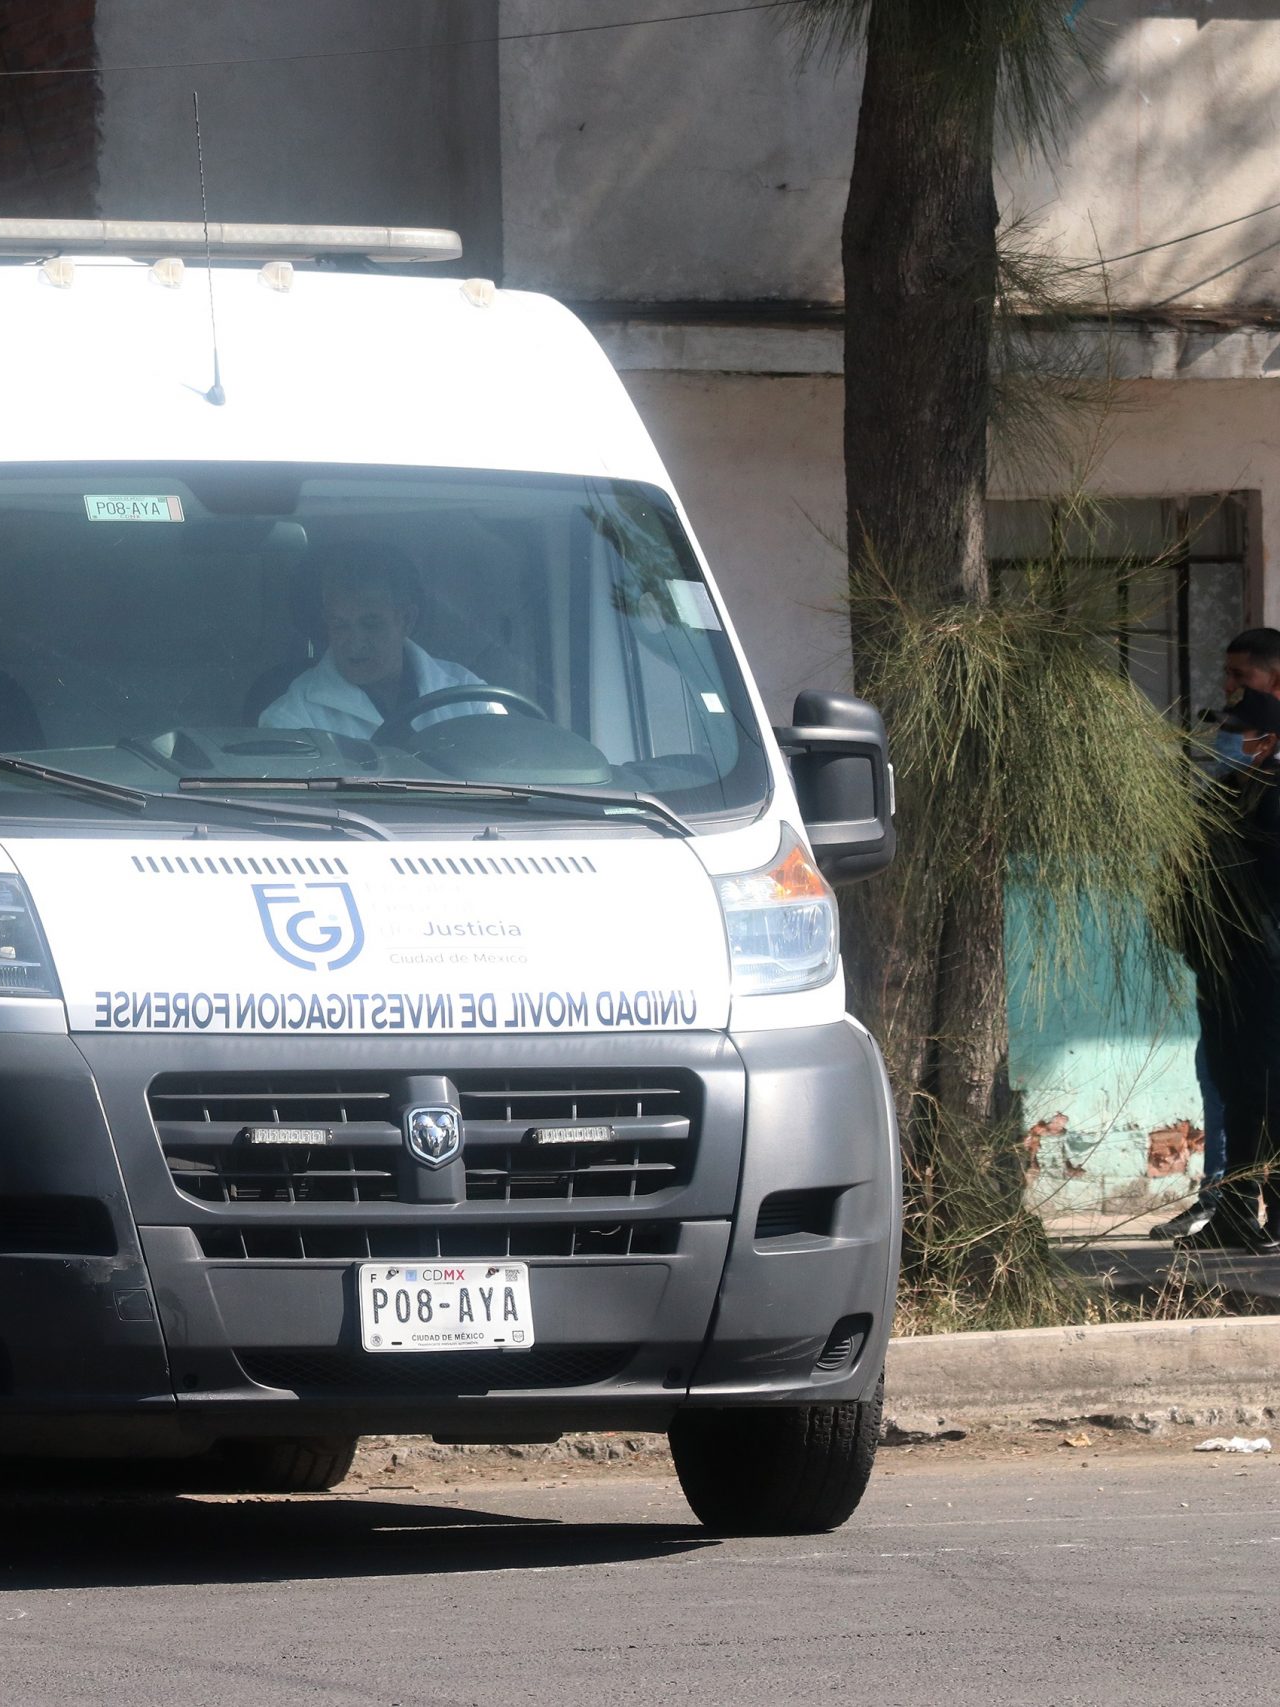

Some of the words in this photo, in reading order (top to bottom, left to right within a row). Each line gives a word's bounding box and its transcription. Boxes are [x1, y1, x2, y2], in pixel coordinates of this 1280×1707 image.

[96, 501, 160, 515] P08-AYA
[423, 921, 522, 936] Justicia
[389, 953, 444, 964] Ciudad
[449, 953, 468, 964] de
[371, 1274, 377, 1283] F
[422, 1269, 465, 1281] CDMX
[372, 1287, 519, 1324] P08-AYA
[411, 1334, 441, 1342] CIUDAD
[442, 1333, 453, 1341] DE
[454, 1331, 485, 1341] MÉXICO
